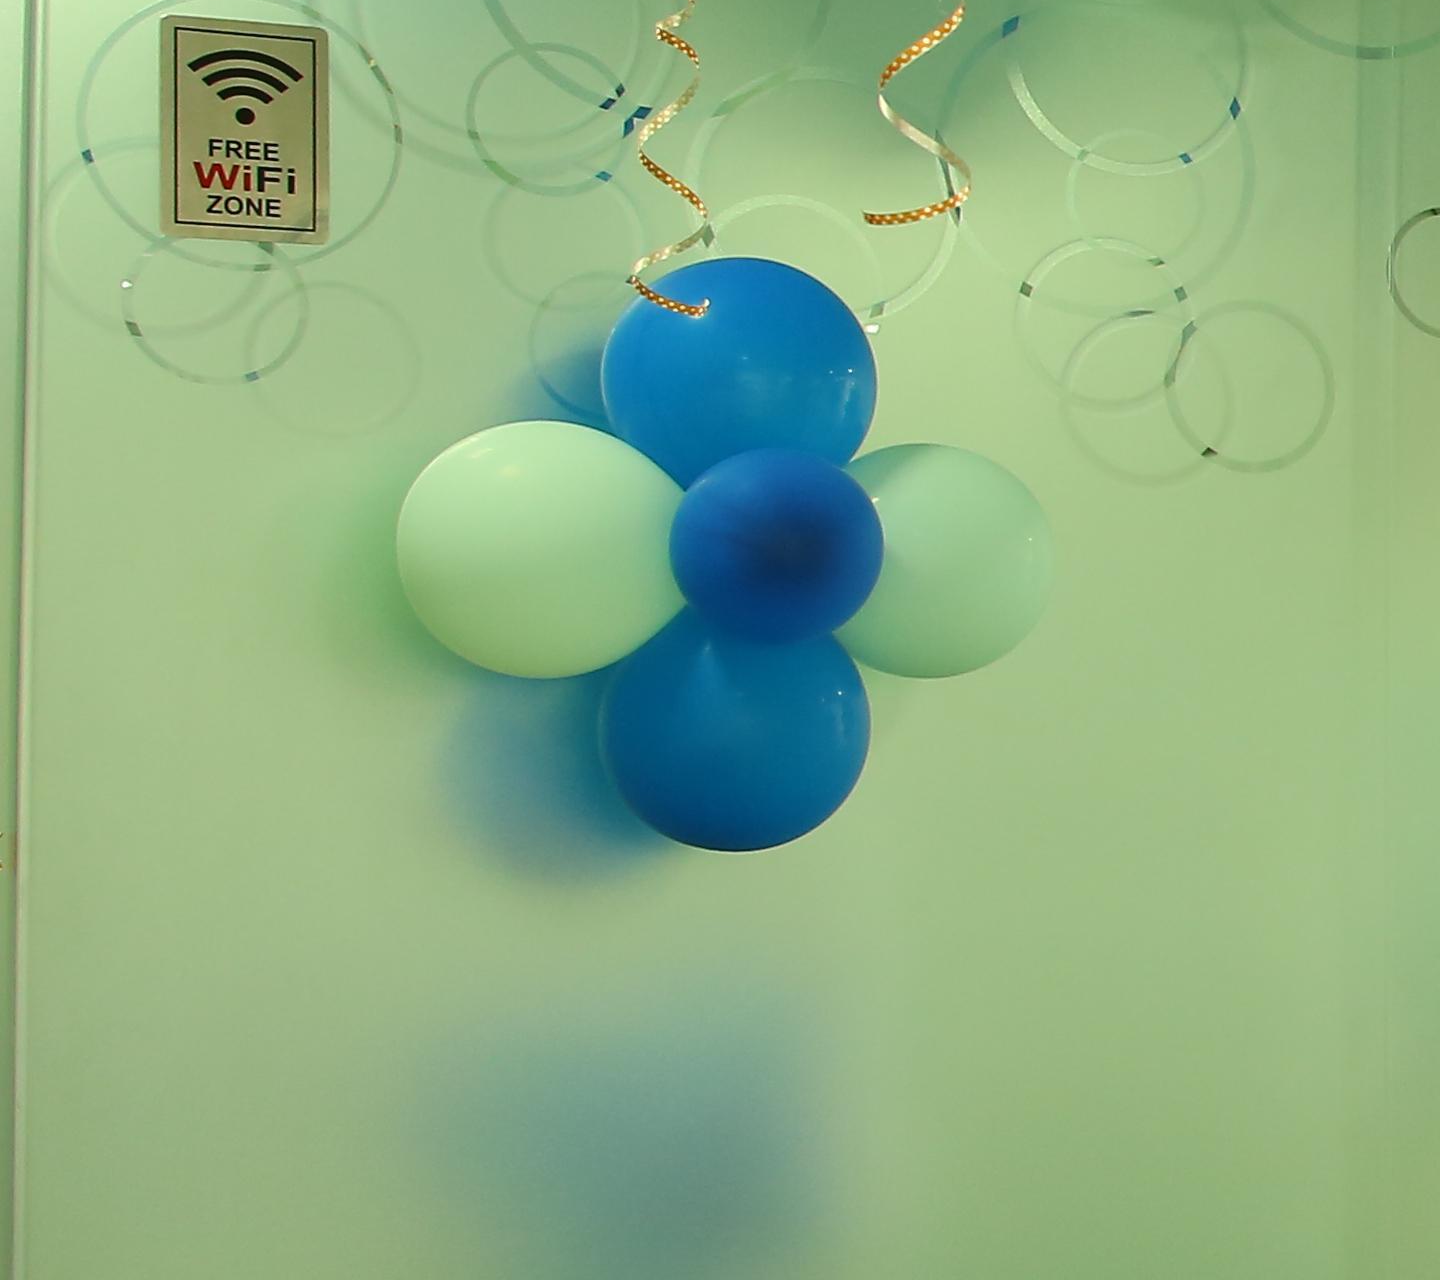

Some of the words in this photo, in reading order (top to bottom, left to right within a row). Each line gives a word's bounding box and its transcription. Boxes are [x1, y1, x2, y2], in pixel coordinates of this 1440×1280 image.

[208, 138, 280, 161] FREE
[193, 161, 296, 195] WiFi
[206, 195, 282, 218] ZONE
